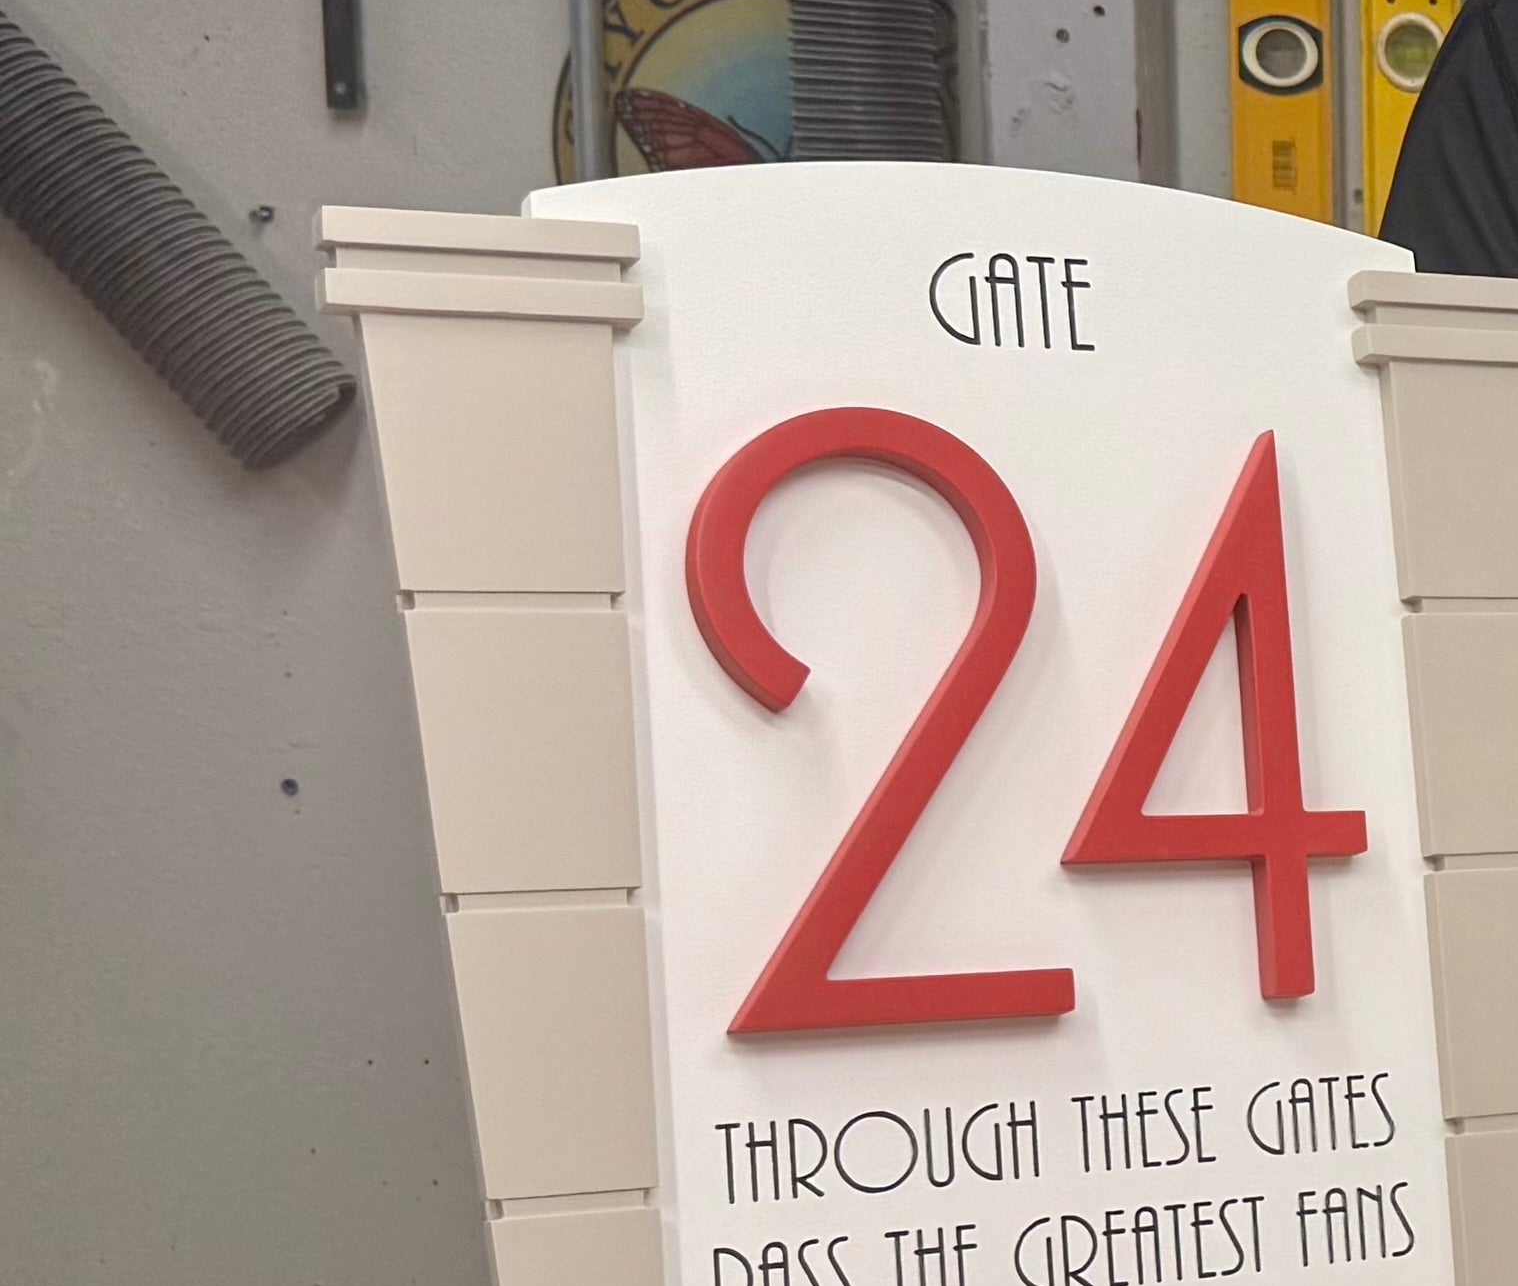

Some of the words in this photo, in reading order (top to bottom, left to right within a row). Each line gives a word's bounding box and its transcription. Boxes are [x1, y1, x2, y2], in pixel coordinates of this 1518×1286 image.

[929, 253, 1095, 351] GATE
[685, 407, 1368, 1034] 24
[715, 1100, 1039, 1204] THROUGH
[1071, 1087, 1216, 1173] THESE
[1247, 1073, 1395, 1155] GATES
[1296, 1182, 1414, 1267] FANS
